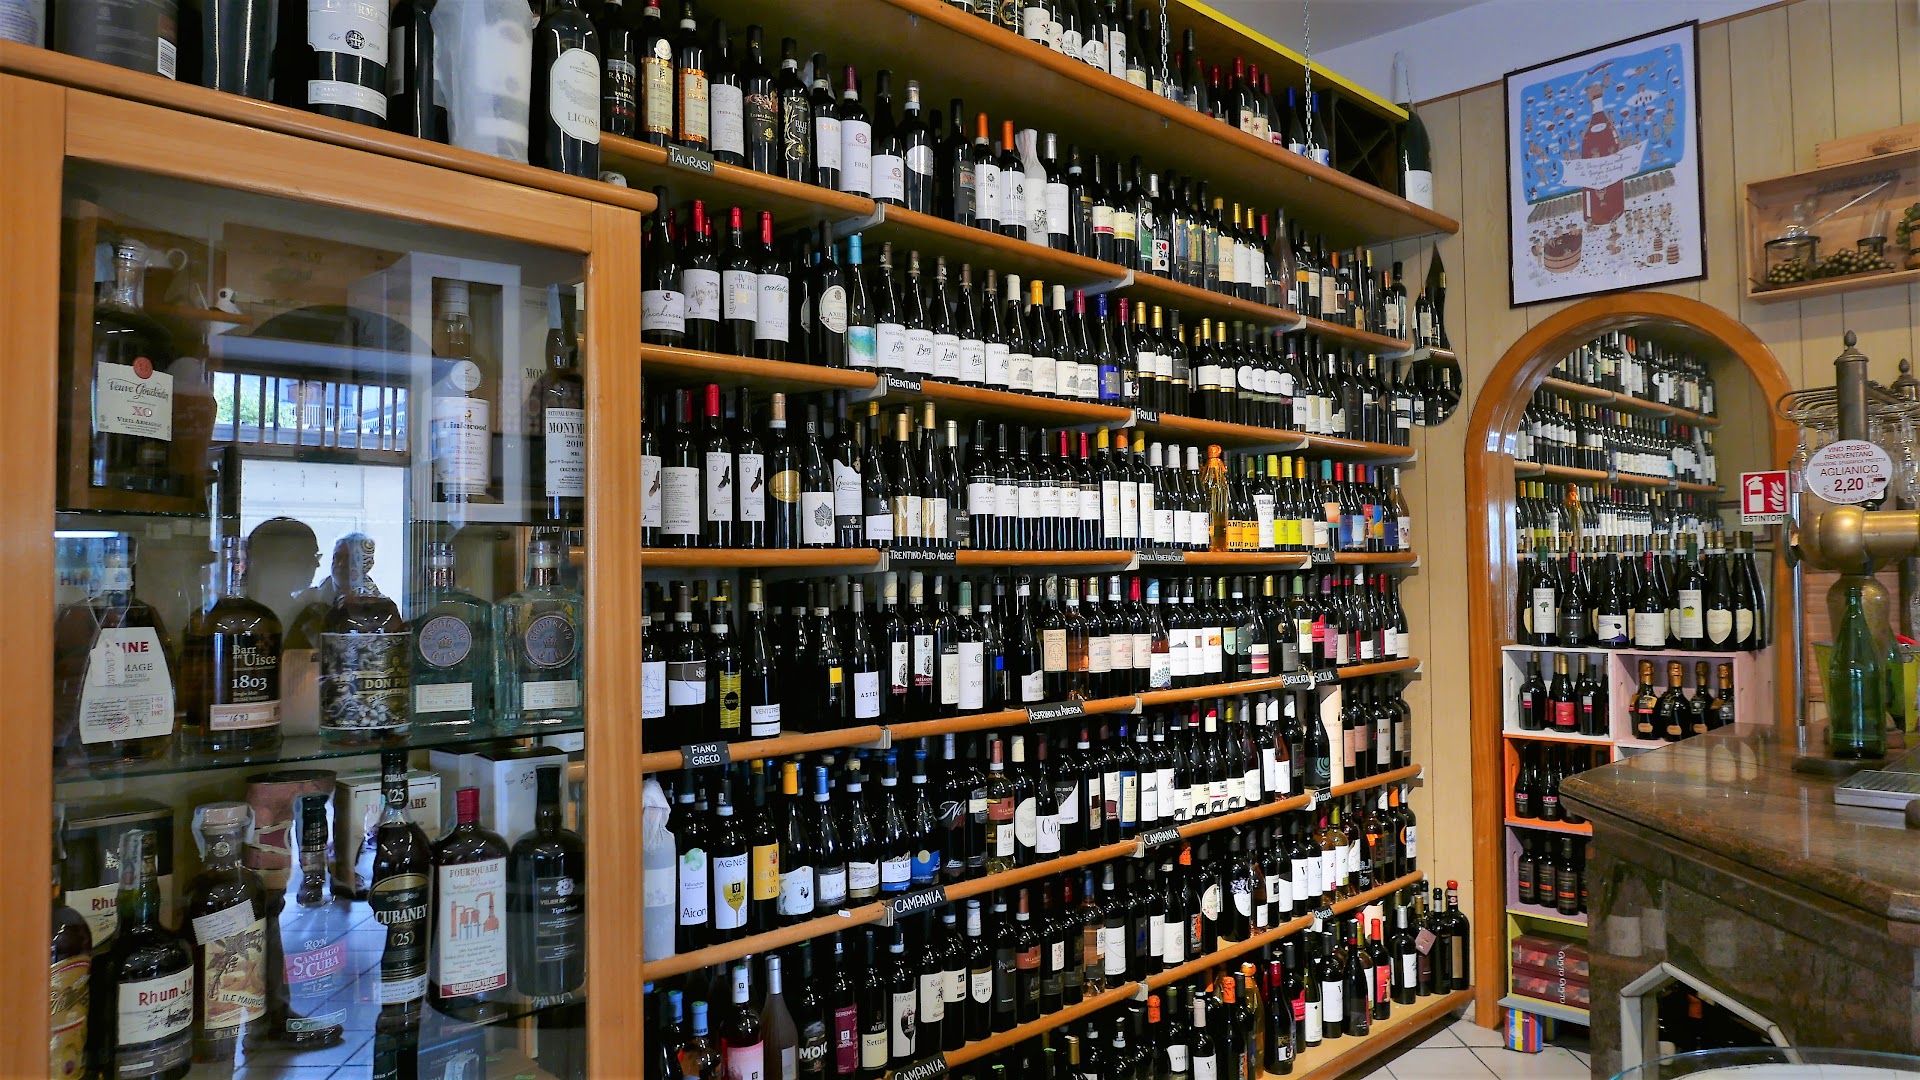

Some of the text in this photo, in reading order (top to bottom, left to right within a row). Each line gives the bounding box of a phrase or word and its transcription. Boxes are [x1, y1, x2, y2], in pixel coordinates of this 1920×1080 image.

[668, 145, 712, 172] TAURASI
[886, 373, 922, 392] TRENTINO
[132, 405, 153, 418] XO
[1137, 407, 1158, 423] FRIULI
[1824, 451, 1874, 460] BENEVENTANO
[1820, 464, 1880, 477] AGLIANICO
[1823, 484, 1830, 493] €
[1834, 478, 1864, 493] 2,20
[1743, 514, 1784, 523] ESTINTOR
[890, 549, 955, 561] TRENTINO ALTO ADIGE
[1312, 553, 1331, 562] SICILIA
[423, 618, 469, 642] BROOKLYN
[529, 619, 574, 642] BROOKLYN
[232, 645, 257, 656] Barr
[431, 650, 458, 663] GIN
[537, 650, 564, 663] GIN
[244, 653, 277, 667] Uisce
[232, 675, 268, 690] 1803
[365, 678, 392, 689] DON
[1282, 674, 1309, 686] BASILICATA
[1314, 671, 1334, 683] SICILIA
[1061, 701, 1082, 716] AVERSA
[691, 744, 718, 755] FIANO
[692, 754, 721, 766] GRECO
[1143, 829, 1180, 846] CAMPANIA
[450, 863, 499, 878] FOURSQUARE
[894, 890, 943, 914] CAMPANIA
[375, 904, 428, 925] CUBANEY
[682, 907, 706, 918] Aicon
[304, 936, 328, 951] RON
[397, 933, 410, 947] 25
[293, 946, 340, 976] SANTIAGO
[305, 955, 340, 978] CUBA
[139, 987, 179, 1007] Rhum
[222, 994, 238, 1003] ILE
[894, 1058, 946, 1080] CAMPANIA
